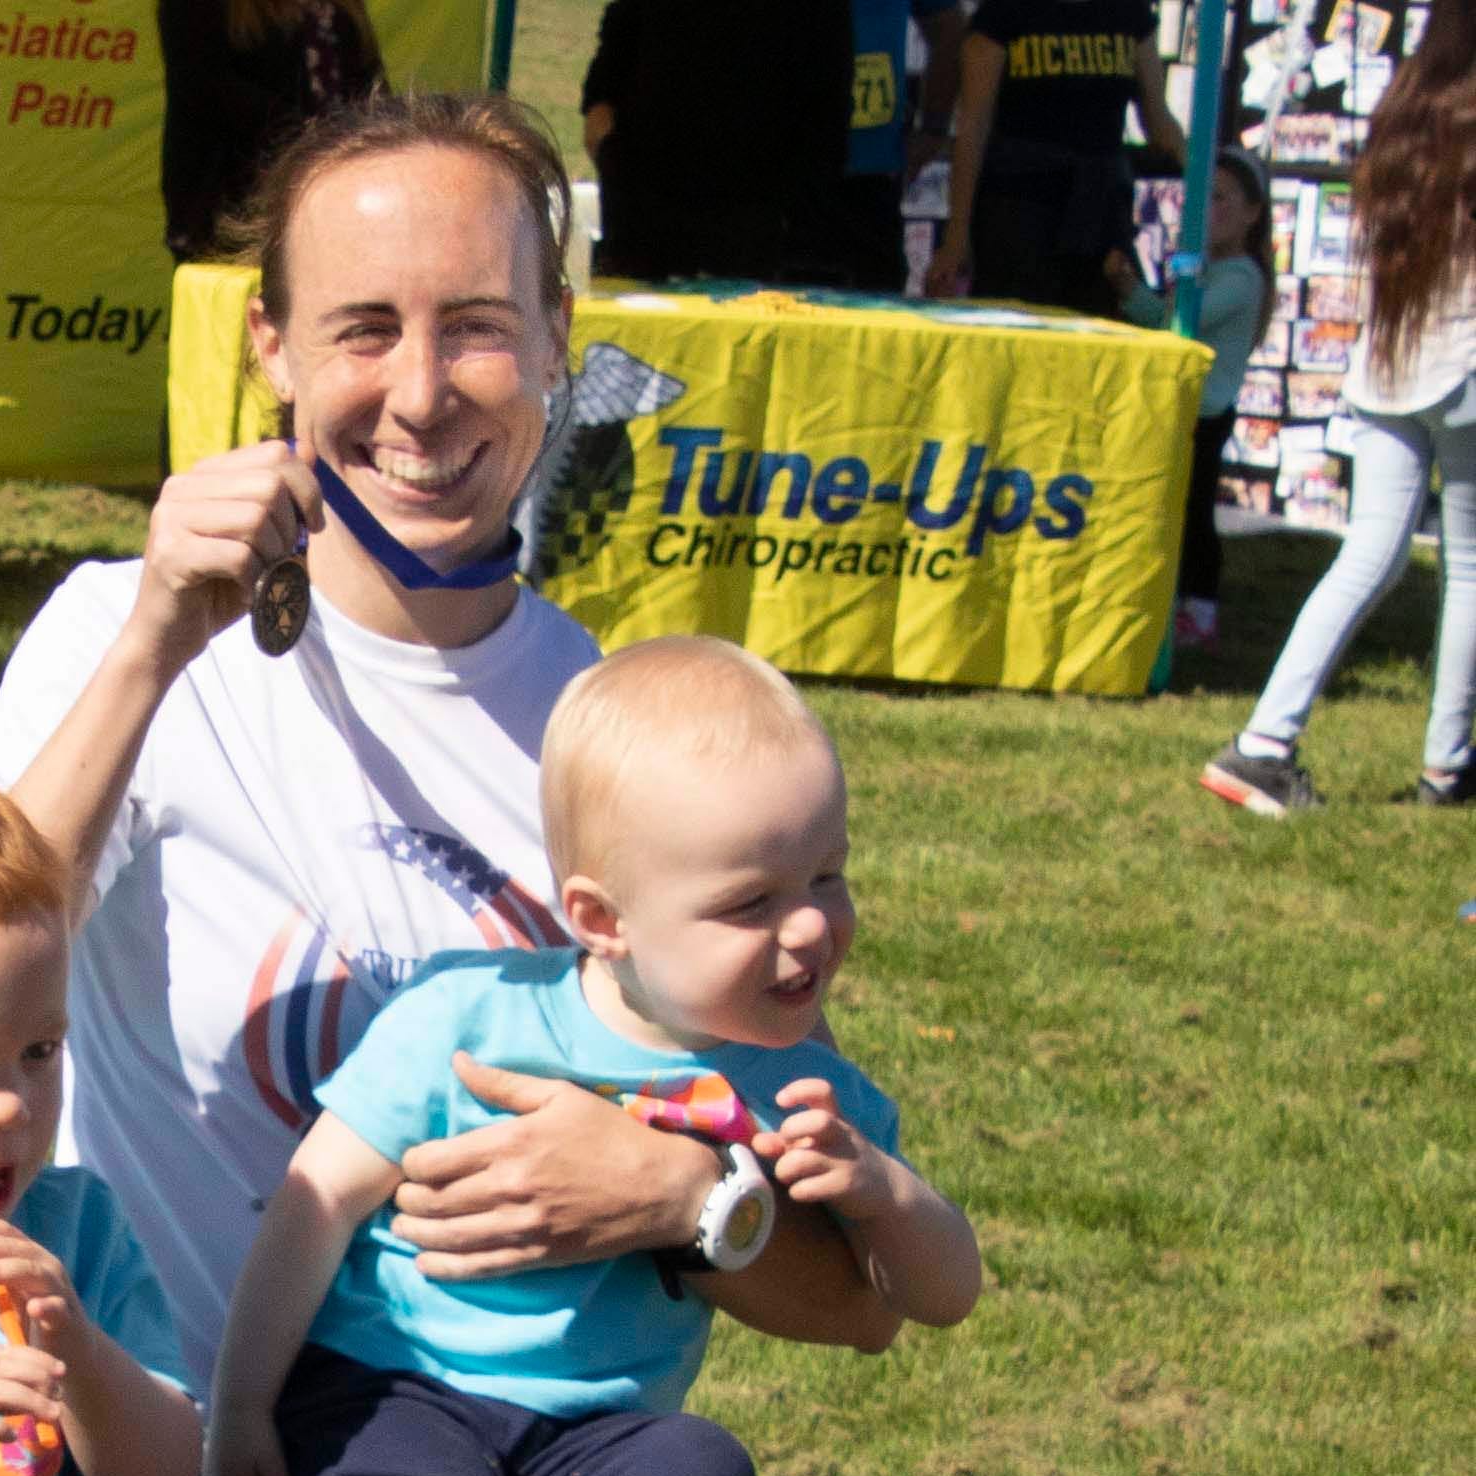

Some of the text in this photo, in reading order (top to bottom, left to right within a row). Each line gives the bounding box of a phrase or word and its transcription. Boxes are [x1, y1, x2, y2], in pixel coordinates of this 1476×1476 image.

[1008, 33, 1136, 78] MICHIGA
[9, 82, 116, 130] Pain
[657, 426, 1095, 557] Tune-Ups
[645, 523, 957, 582] Chiropractic
